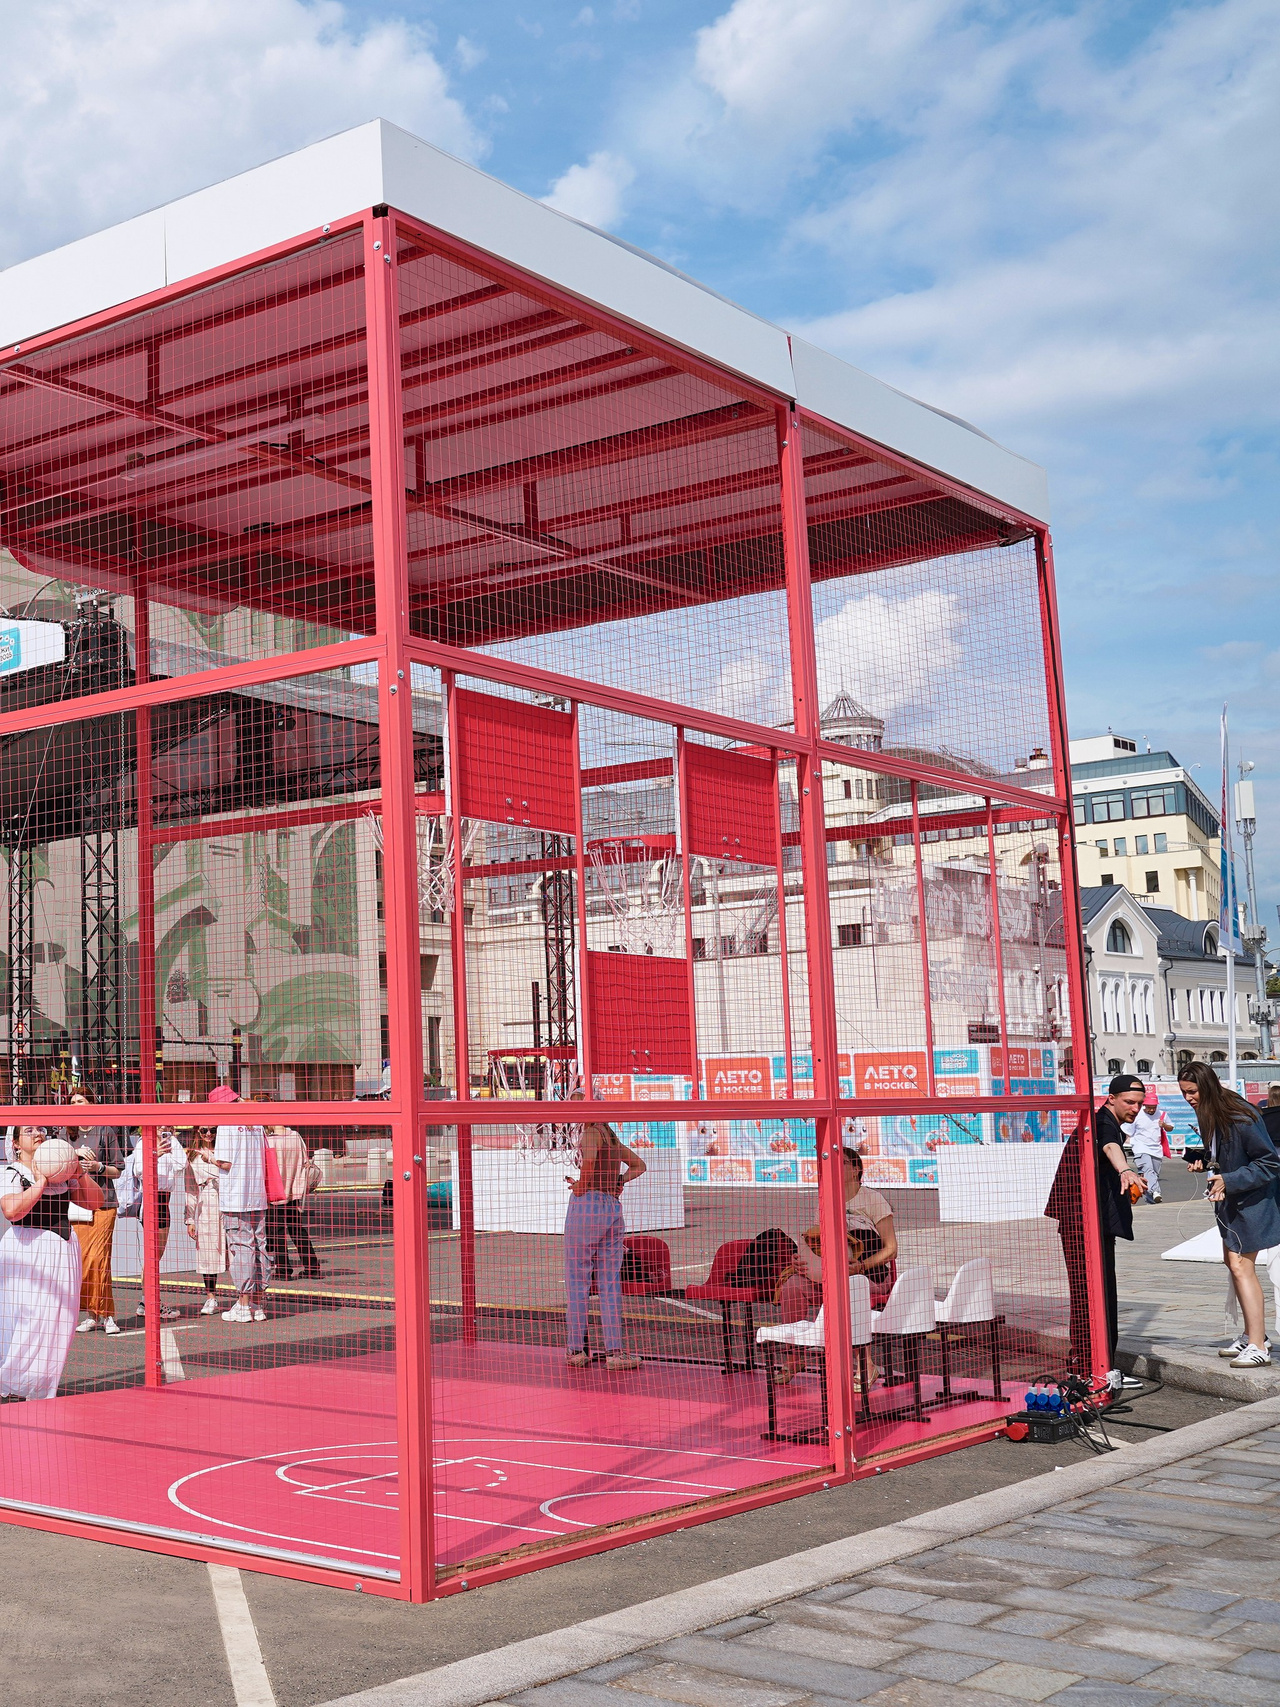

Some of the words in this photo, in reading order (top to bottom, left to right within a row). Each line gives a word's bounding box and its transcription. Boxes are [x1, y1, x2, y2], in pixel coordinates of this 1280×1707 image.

[714, 1069, 762, 1084] ЛЕТО
[864, 1064, 918, 1080] ЛЕТО
[723, 1085, 763, 1093] МОСКВЕ
[863, 1082, 871, 1090] В
[874, 1081, 918, 1090] МОСКВЕ
